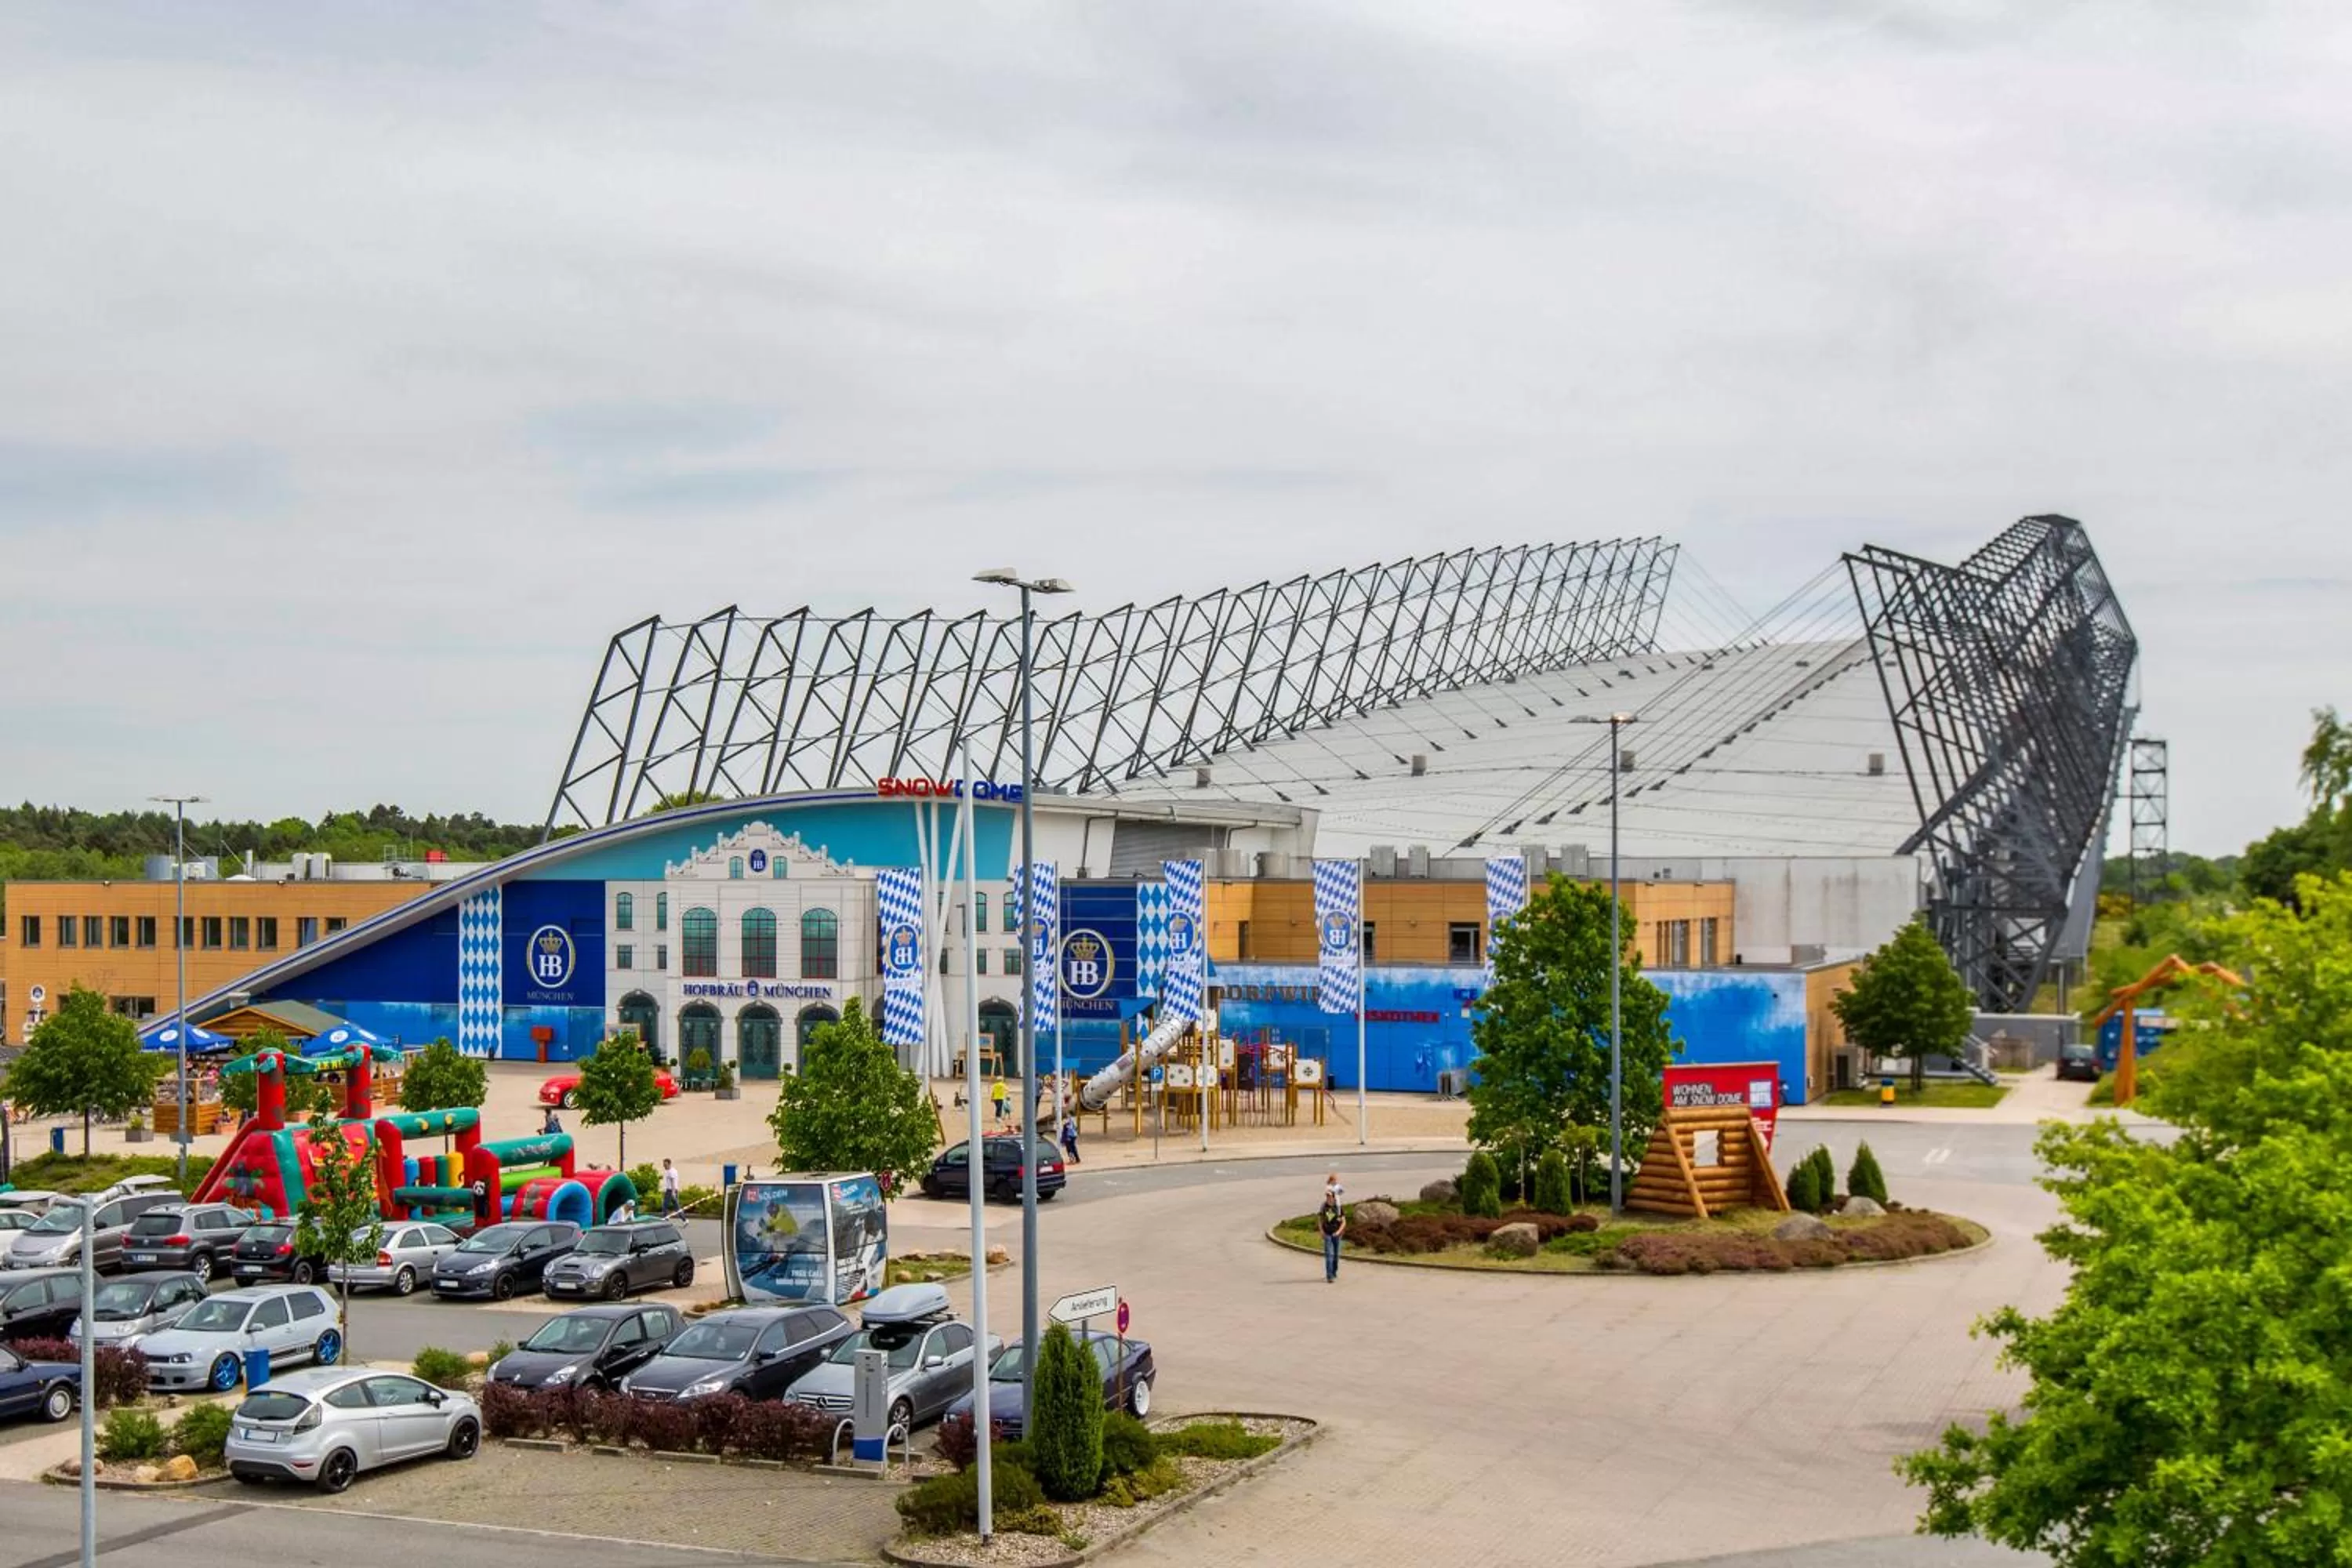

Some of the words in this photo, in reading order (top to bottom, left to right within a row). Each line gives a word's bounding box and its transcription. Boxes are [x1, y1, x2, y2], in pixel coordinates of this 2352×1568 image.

[539, 954, 563, 978] HB
[1069, 960, 1098, 985] HB
[683, 982, 744, 997] HOFBRÄU
[764, 983, 833, 999] MÜNCHEN
[1153, 1069, 1161, 1080] P
[1673, 1084, 1712, 1095] WOHNEN
[1674, 1096, 1688, 1105] AM
[1690, 1094, 1715, 1105] SNOW
[1718, 1093, 1742, 1105] DOME
